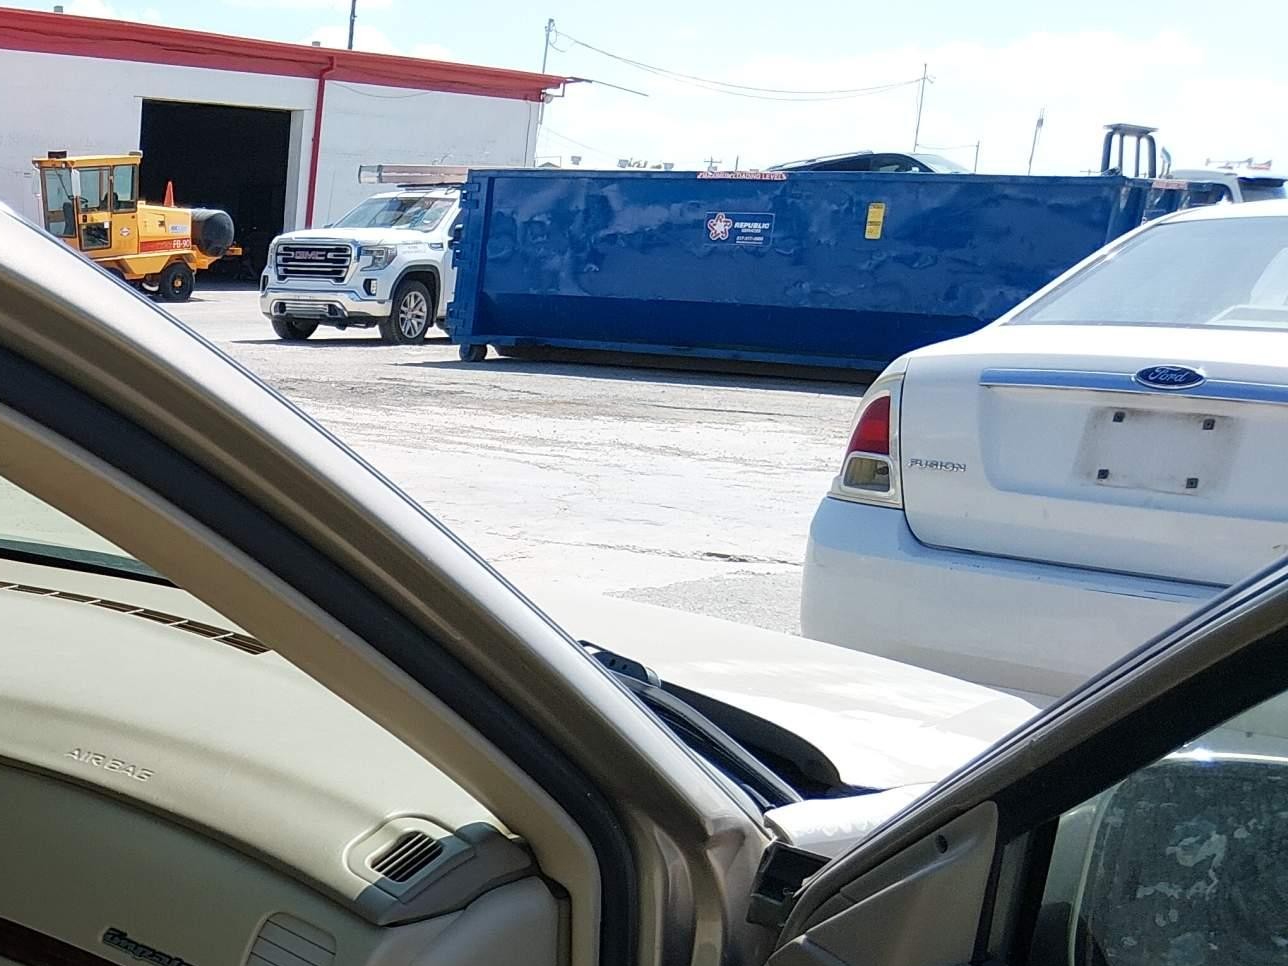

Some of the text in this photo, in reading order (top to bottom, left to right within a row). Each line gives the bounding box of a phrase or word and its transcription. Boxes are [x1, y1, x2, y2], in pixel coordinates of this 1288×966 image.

[293, 250, 327, 260] GMC
[1148, 366, 1187, 383] Ford
[910, 458, 967, 472] FUSION
